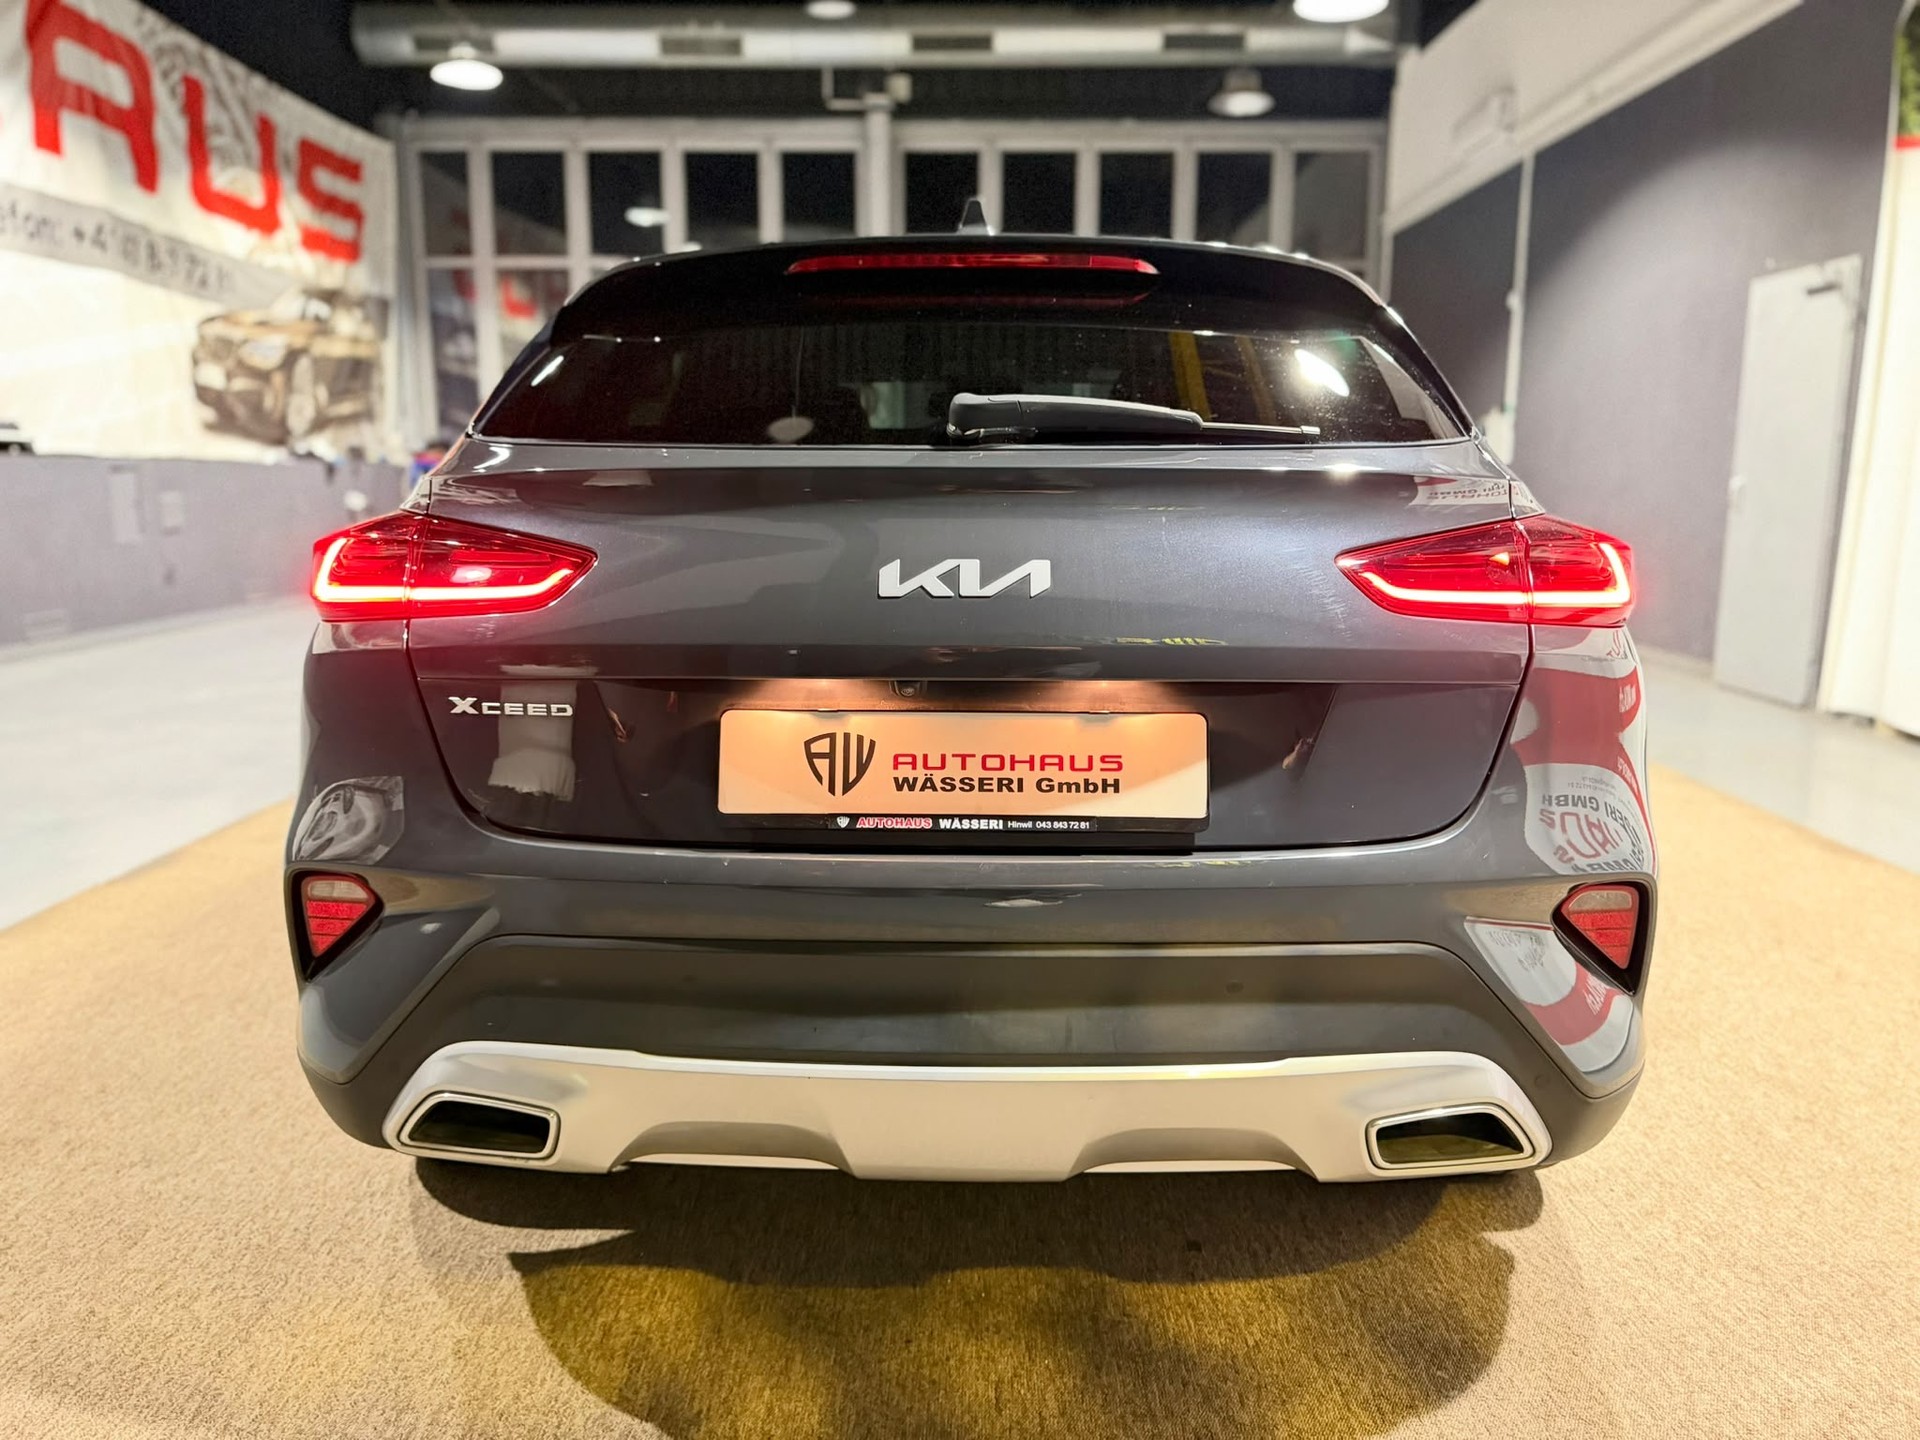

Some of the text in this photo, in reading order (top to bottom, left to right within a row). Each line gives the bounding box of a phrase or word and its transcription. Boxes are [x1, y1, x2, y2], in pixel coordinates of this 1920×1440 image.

[878, 558, 1053, 598] KIA
[892, 753, 1124, 773] AUTOHAUS
[893, 773, 1120, 794] WÄSSERI GmbH
[856, 816, 933, 829] AUTOHAUS
[939, 817, 1004, 830] WÄSSERI
[1007, 820, 1033, 829] Hinwil
[1035, 820, 1052, 829] 043
[1052, 821, 1068, 829] 843
[1068, 821, 1079, 829] 72
[1079, 821, 1090, 830] 81
